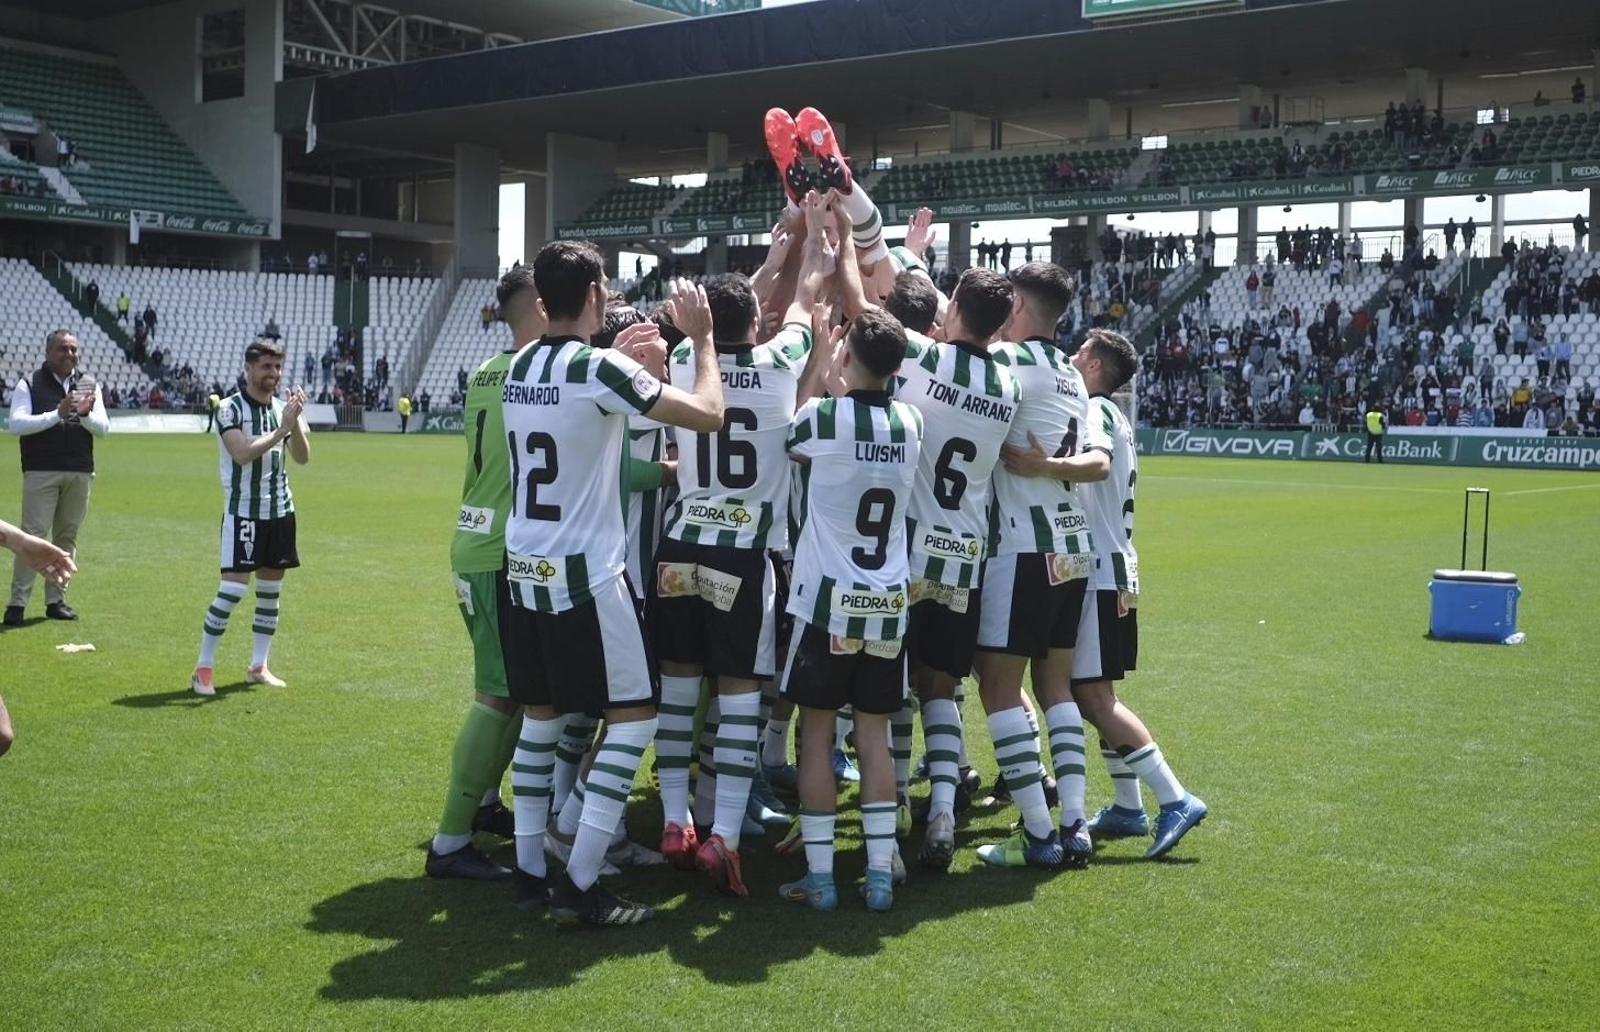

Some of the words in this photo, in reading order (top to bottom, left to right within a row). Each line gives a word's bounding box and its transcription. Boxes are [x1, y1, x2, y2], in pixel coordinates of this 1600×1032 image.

[1043, 198, 1078, 208] SILBON
[1091, 195, 1128, 205] SILBON
[1141, 192, 1179, 202] SILBON
[559, 224, 648, 238] tienda.cordobacf.com
[472, 370, 502, 387] FELIPE
[721, 371, 762, 389] PUGA
[502, 384, 560, 405] BERNARDO
[925, 378, 960, 407] TONI
[961, 394, 1013, 424] ARRANZ
[473, 408, 487, 478] 1
[697, 407, 758, 489] 16
[855, 442, 906, 463] LUISMI
[1185, 437, 1294, 455] GIVOVA
[508, 430, 562, 522] 12
[934, 437, 977, 511] 6
[239, 520, 256, 542] 21
[852, 488, 896, 570] 9
[1505, 589, 1515, 626] Coleman
